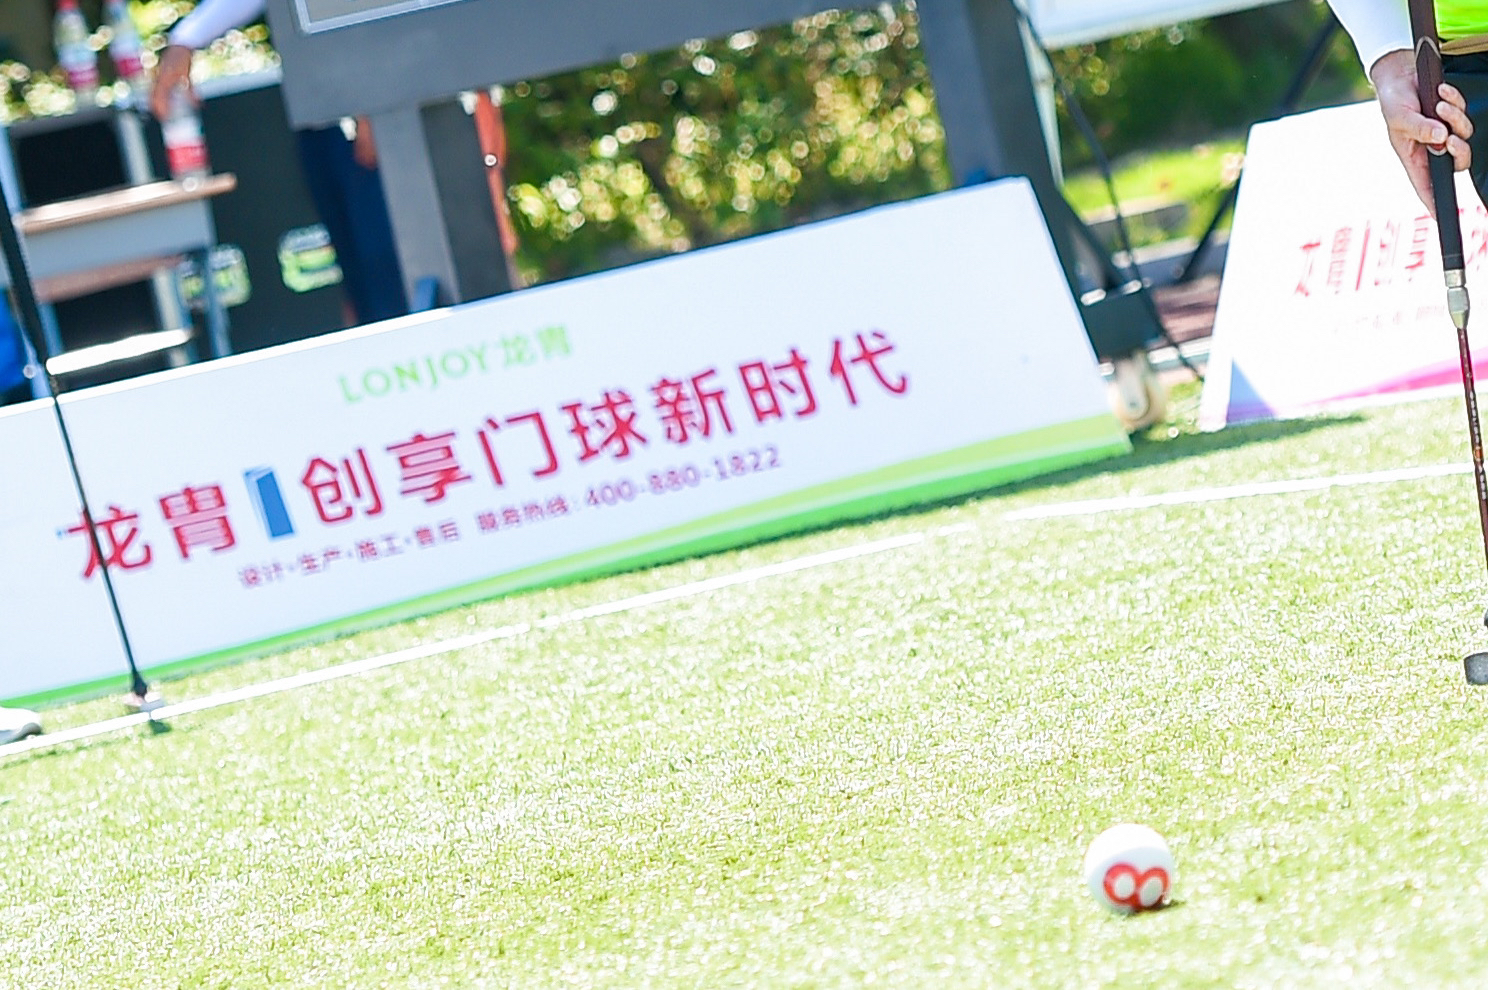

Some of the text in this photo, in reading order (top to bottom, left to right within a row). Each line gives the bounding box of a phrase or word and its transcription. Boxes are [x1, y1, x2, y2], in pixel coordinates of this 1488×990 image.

[337, 342, 494, 405] LONJOY
[66, 328, 911, 581] 龙胄 创享门球新时代
